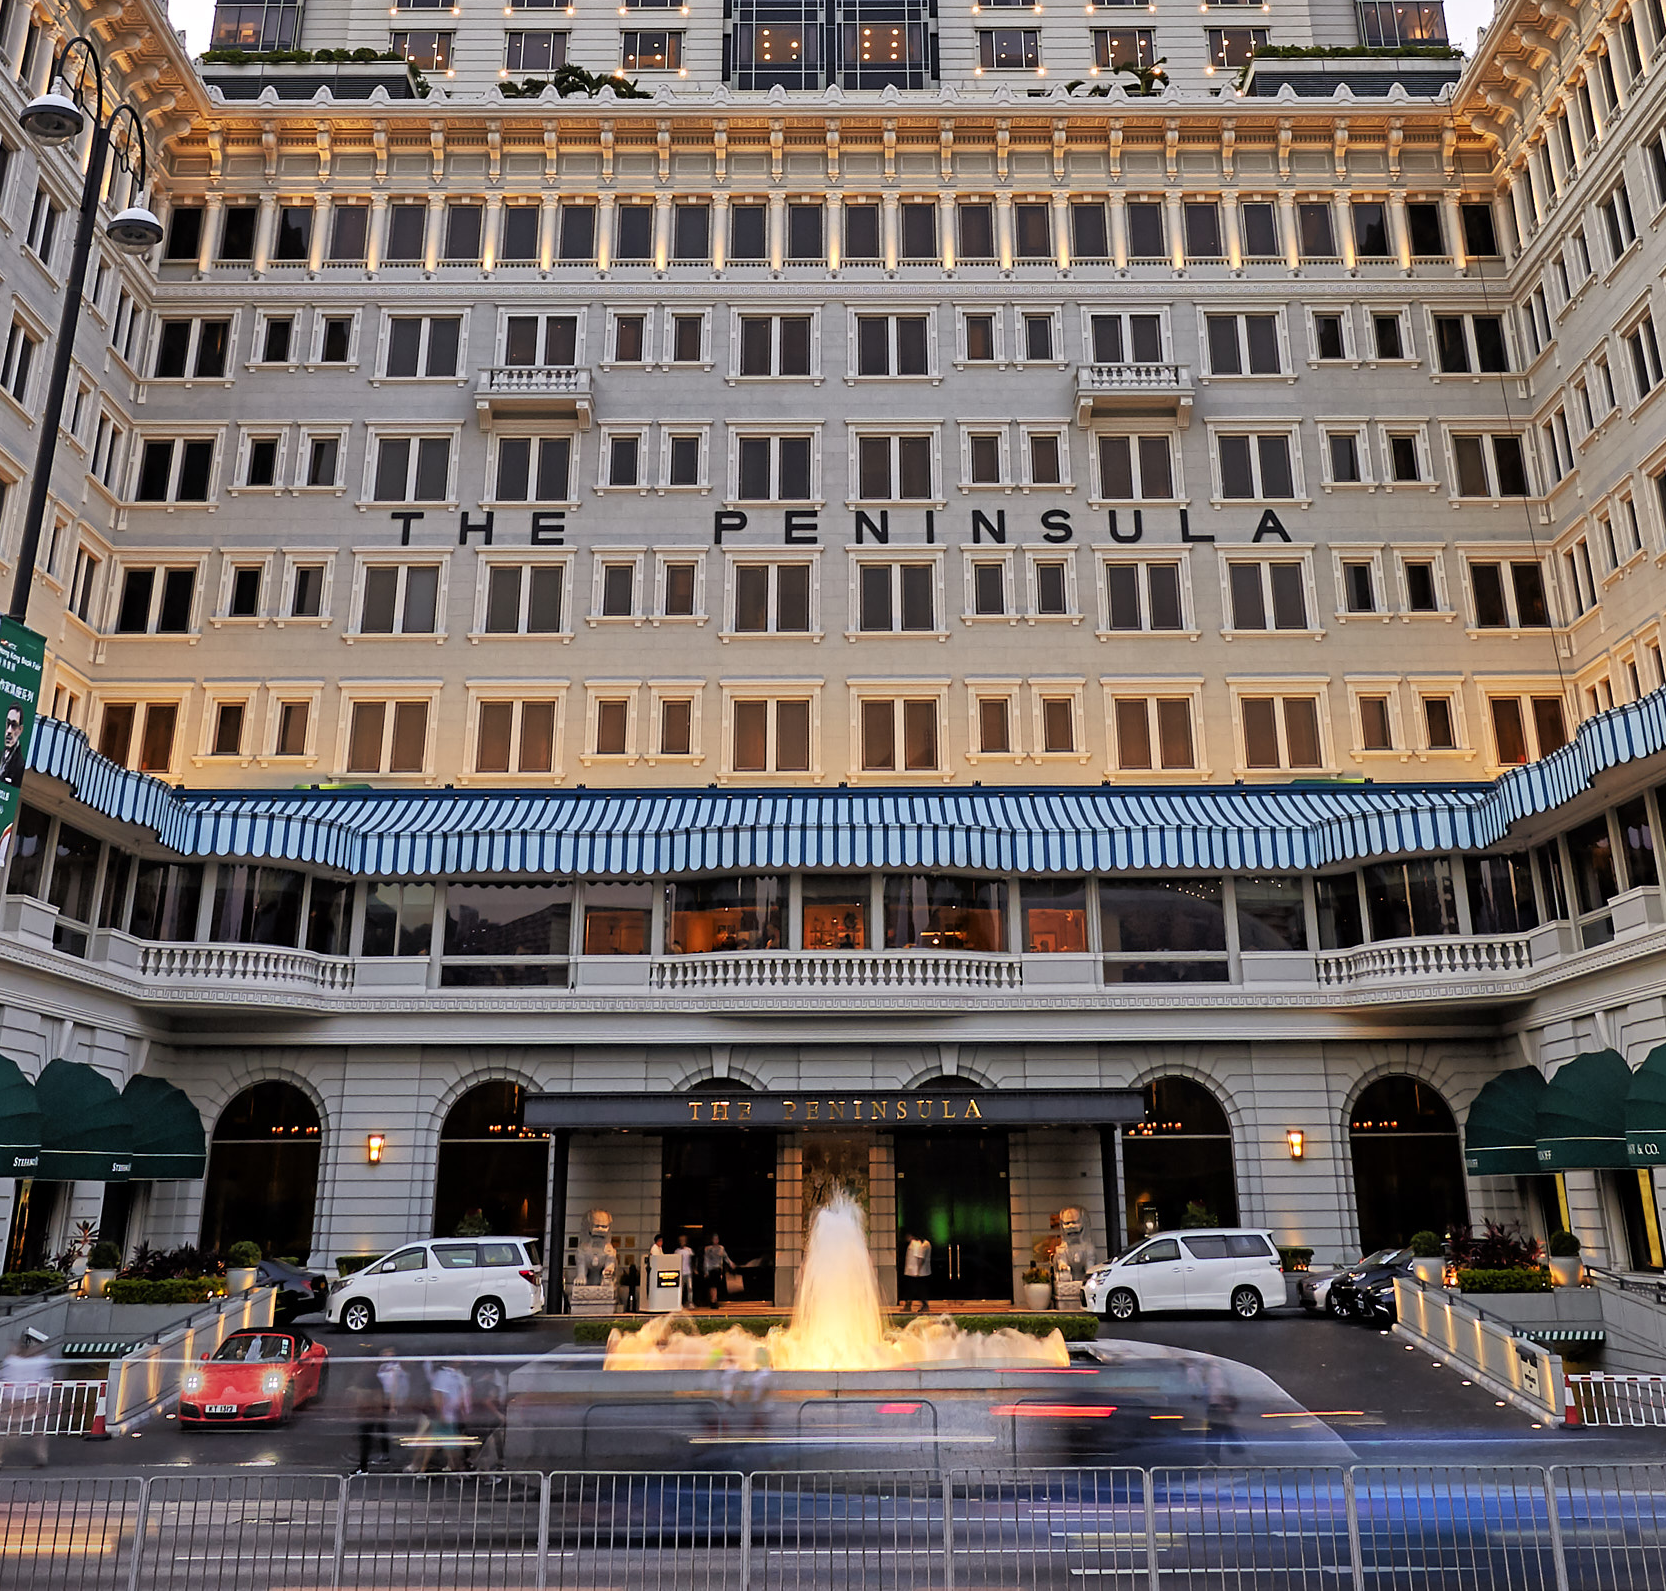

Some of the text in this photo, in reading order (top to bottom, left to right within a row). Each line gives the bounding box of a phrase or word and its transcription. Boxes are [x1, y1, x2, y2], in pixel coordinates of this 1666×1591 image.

[391, 509, 1292, 546] THE PENINSULA
[688, 1099, 983, 1121] THE PENINSULA
